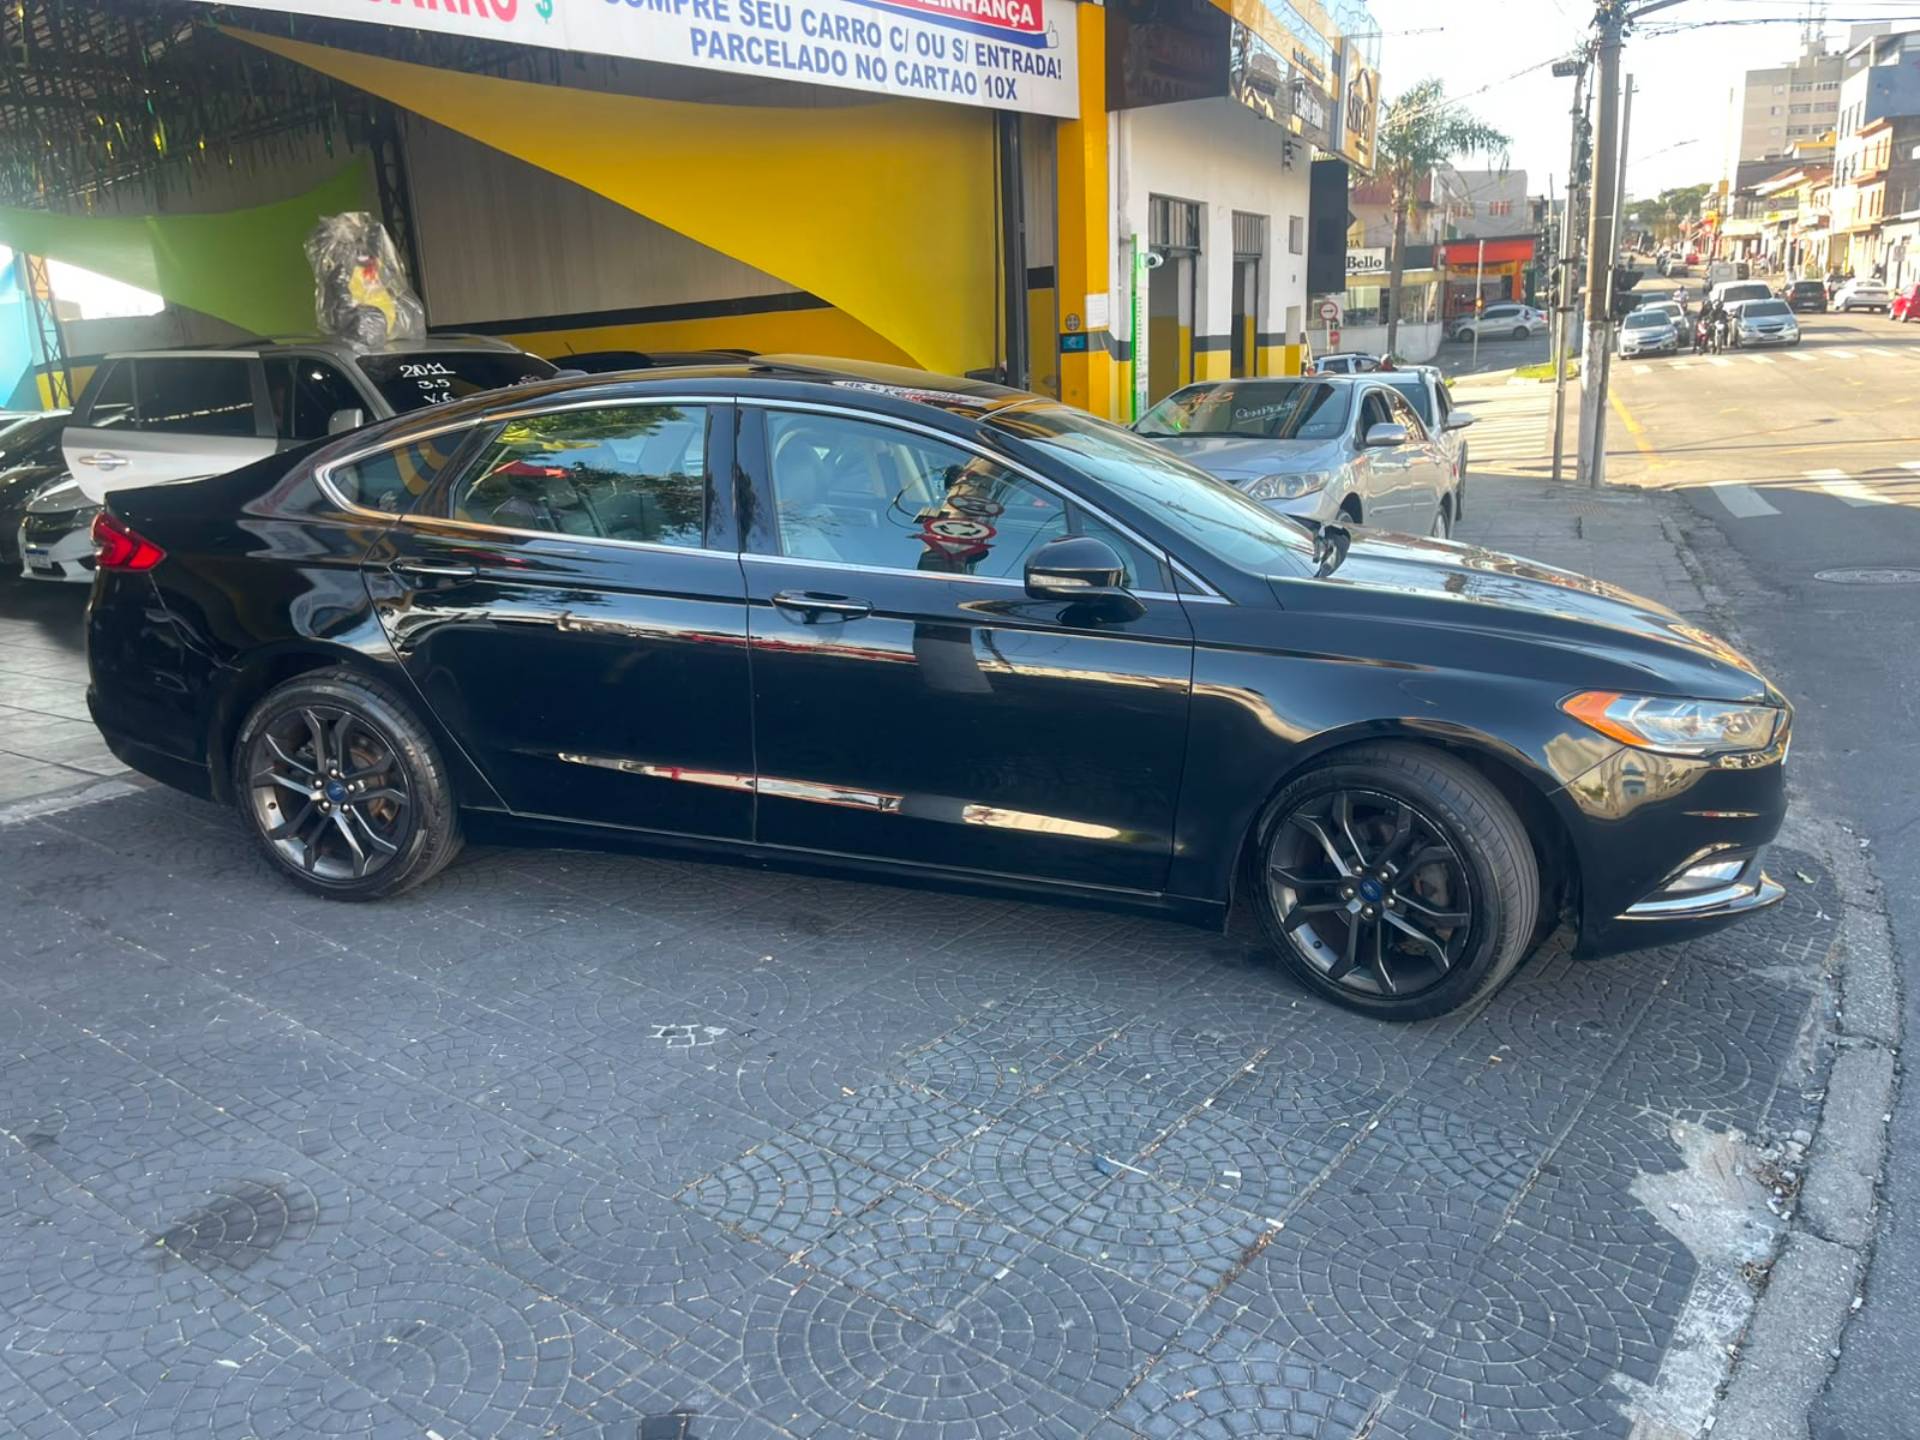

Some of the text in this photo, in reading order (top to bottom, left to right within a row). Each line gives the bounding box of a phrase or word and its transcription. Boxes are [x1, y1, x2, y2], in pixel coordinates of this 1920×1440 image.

[739, 0, 792, 32] SEU
[800, 8, 882, 49] CARRO
[889, 26, 909, 53] C/
[916, 31, 945, 58] OU
[952, 37, 969, 64] S/
[975, 43, 1062, 80] ENTRADA!
[690, 27, 1018, 100] PARCELADO NO CARTAO 10X
[1347, 256, 1382, 269] Bello
[400, 363, 456, 378] 2011
[416, 378, 450, 390] 3.5
